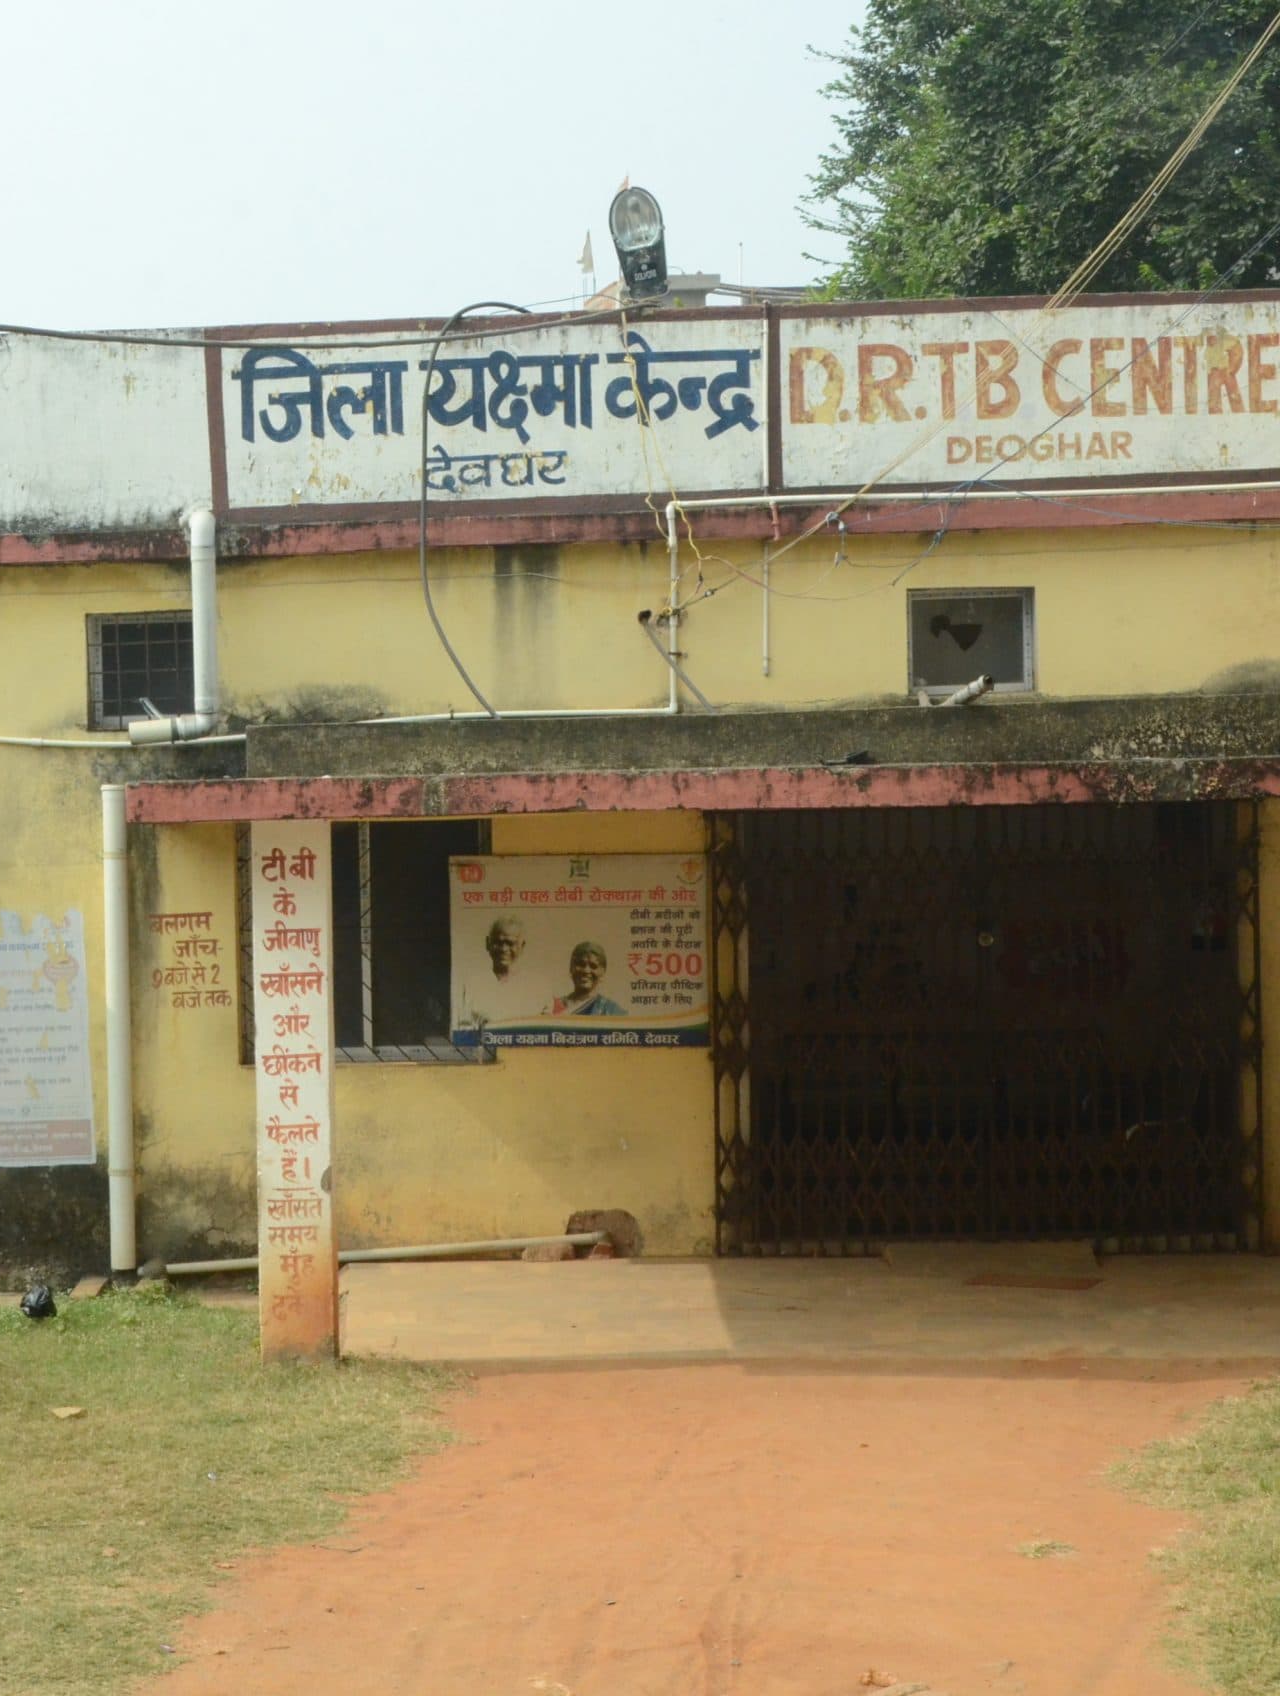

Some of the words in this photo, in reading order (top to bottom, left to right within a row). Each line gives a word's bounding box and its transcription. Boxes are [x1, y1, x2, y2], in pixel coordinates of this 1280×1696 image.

[231, 346, 408, 444] जिला
[604, 331, 761, 441] केन्द्र
[1041, 332, 1280, 418] CENTRE
[946, 431, 1133, 466] DEOGHAR
[425, 444, 567, 493] देवघर
[273, 886, 296, 915] के
[463, 890, 484, 904] एक
[262, 920, 322, 957] जीवाणु
[627, 952, 704, 977] ₹500
[279, 1078, 299, 1111] से
[265, 1115, 320, 1145] फैलते
